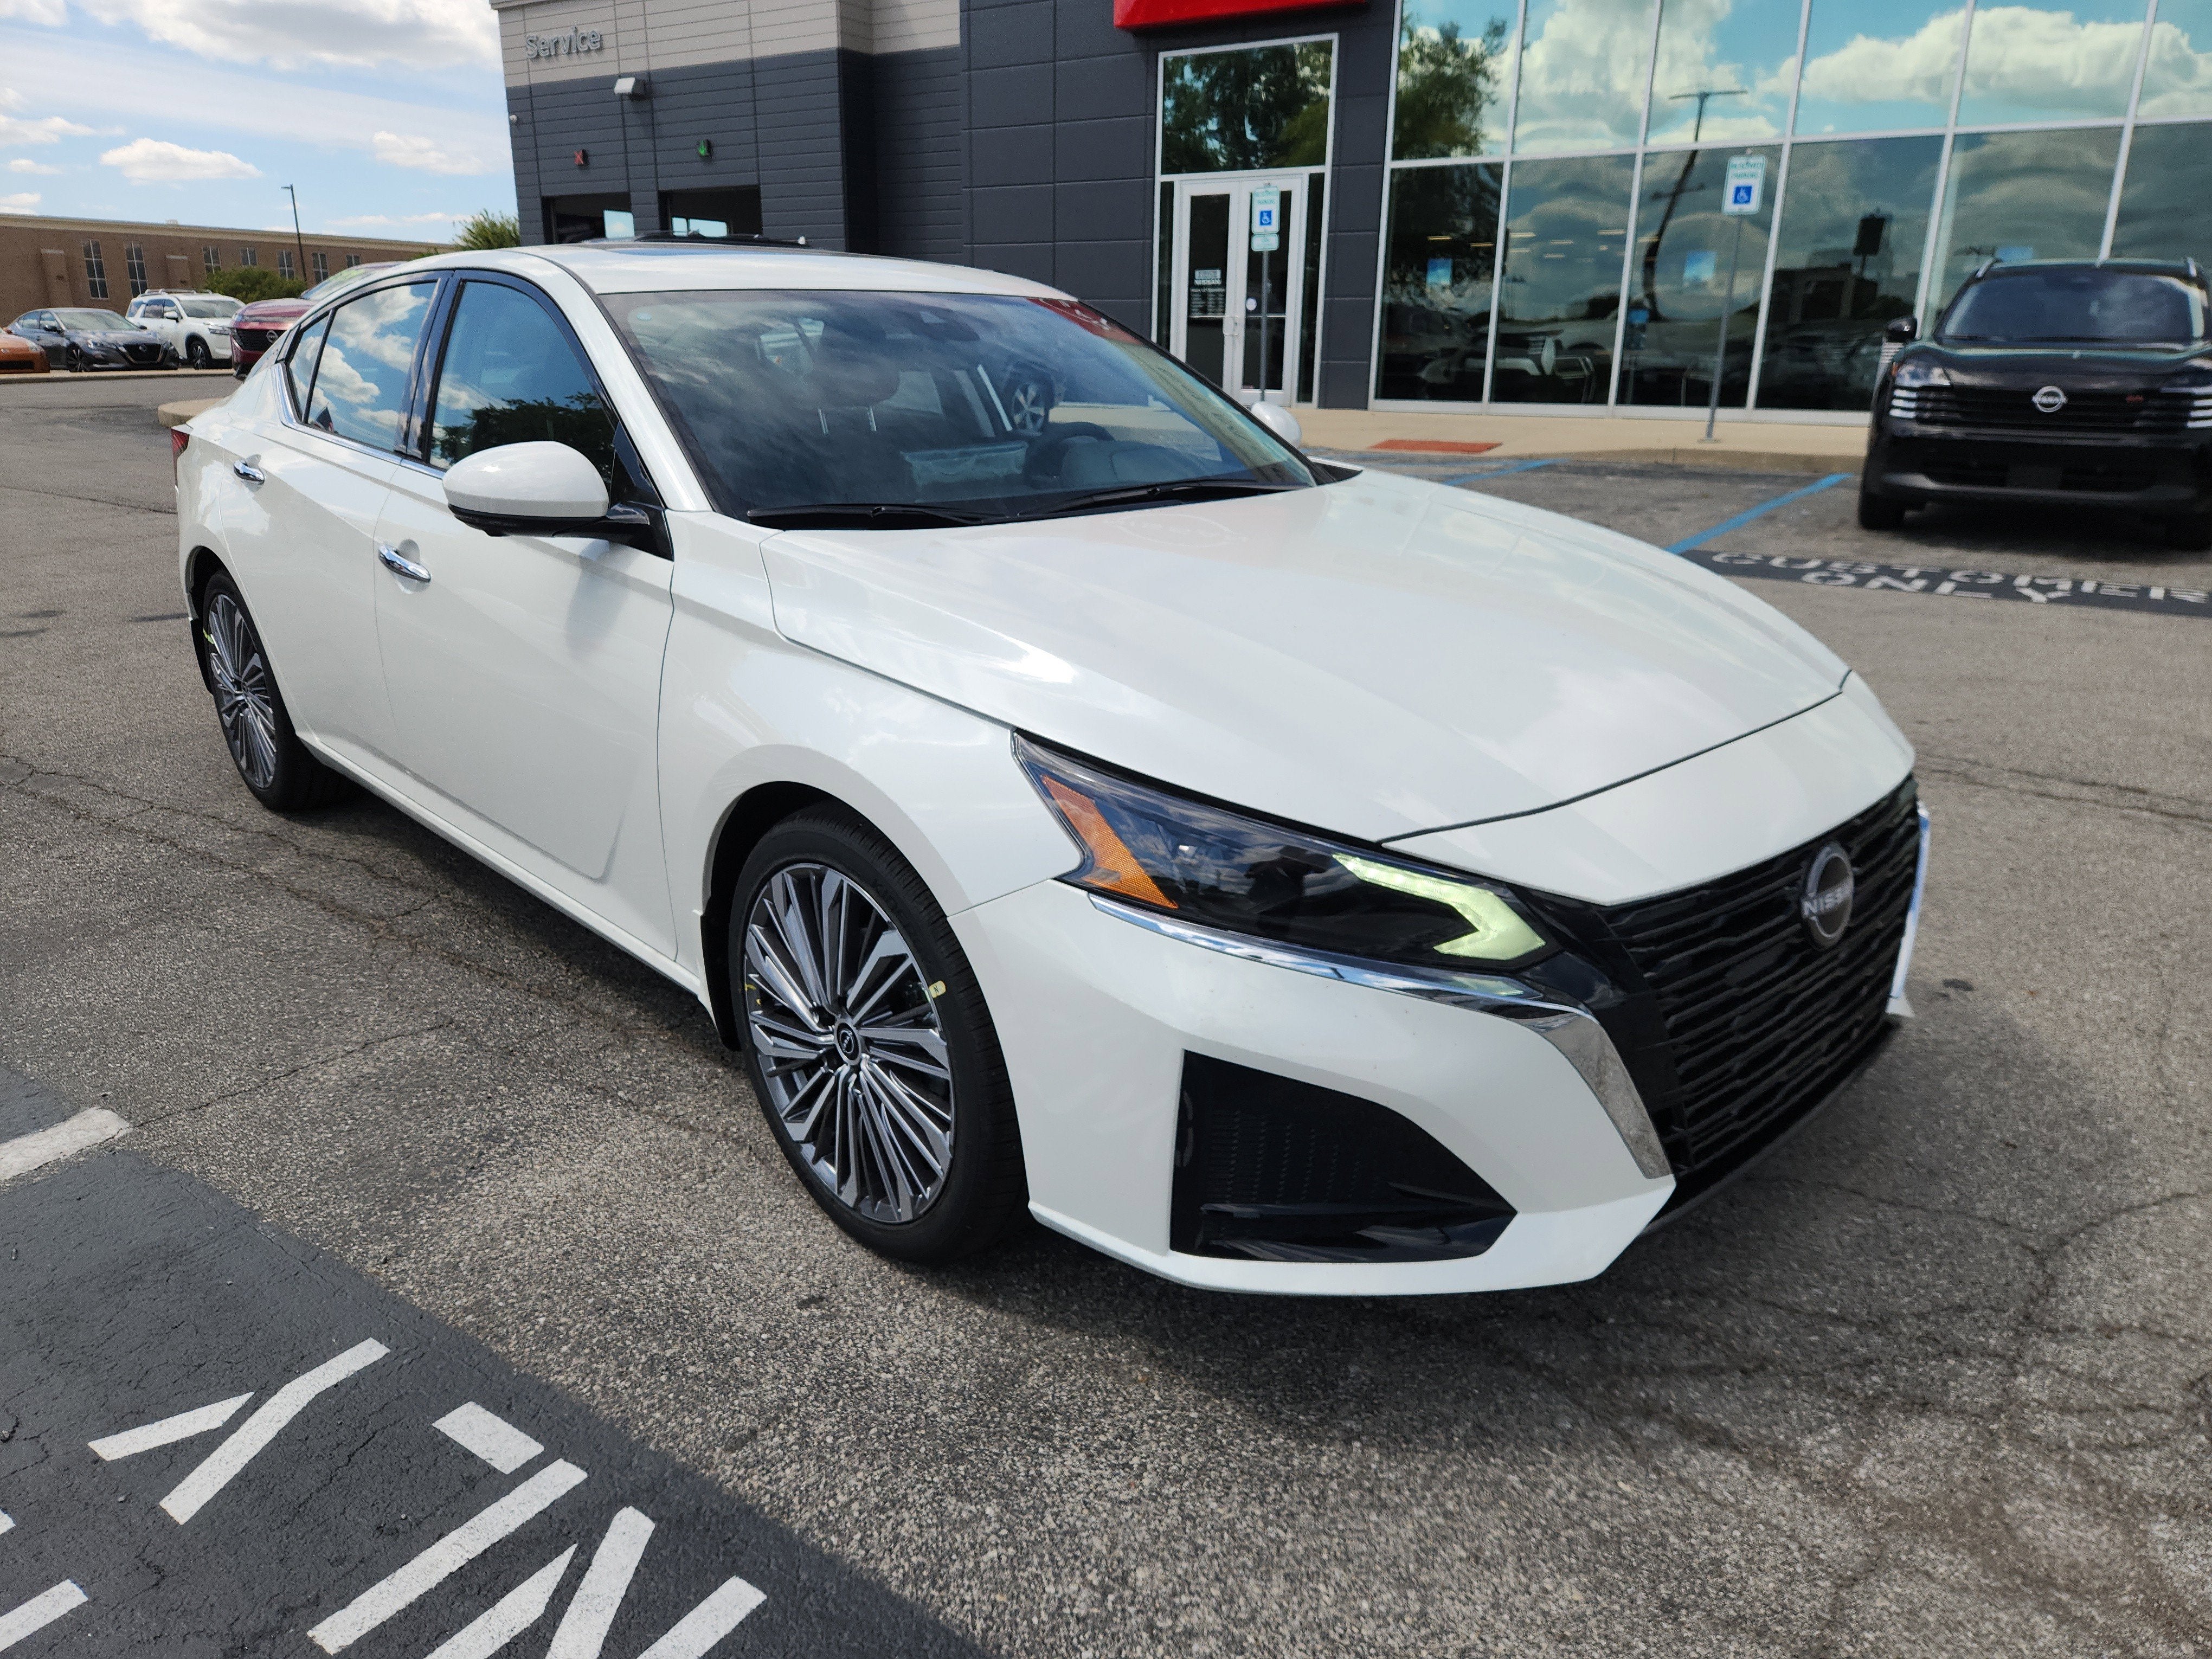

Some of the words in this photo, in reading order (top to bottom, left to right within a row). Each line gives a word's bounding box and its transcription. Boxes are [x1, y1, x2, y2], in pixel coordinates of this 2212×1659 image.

[525, 27, 601, 59] Service
[1712, 552, 2208, 603] CUSTOMER
[1802, 571, 2072, 603] ONLY
[88, 1337, 767, 1659] NLY
